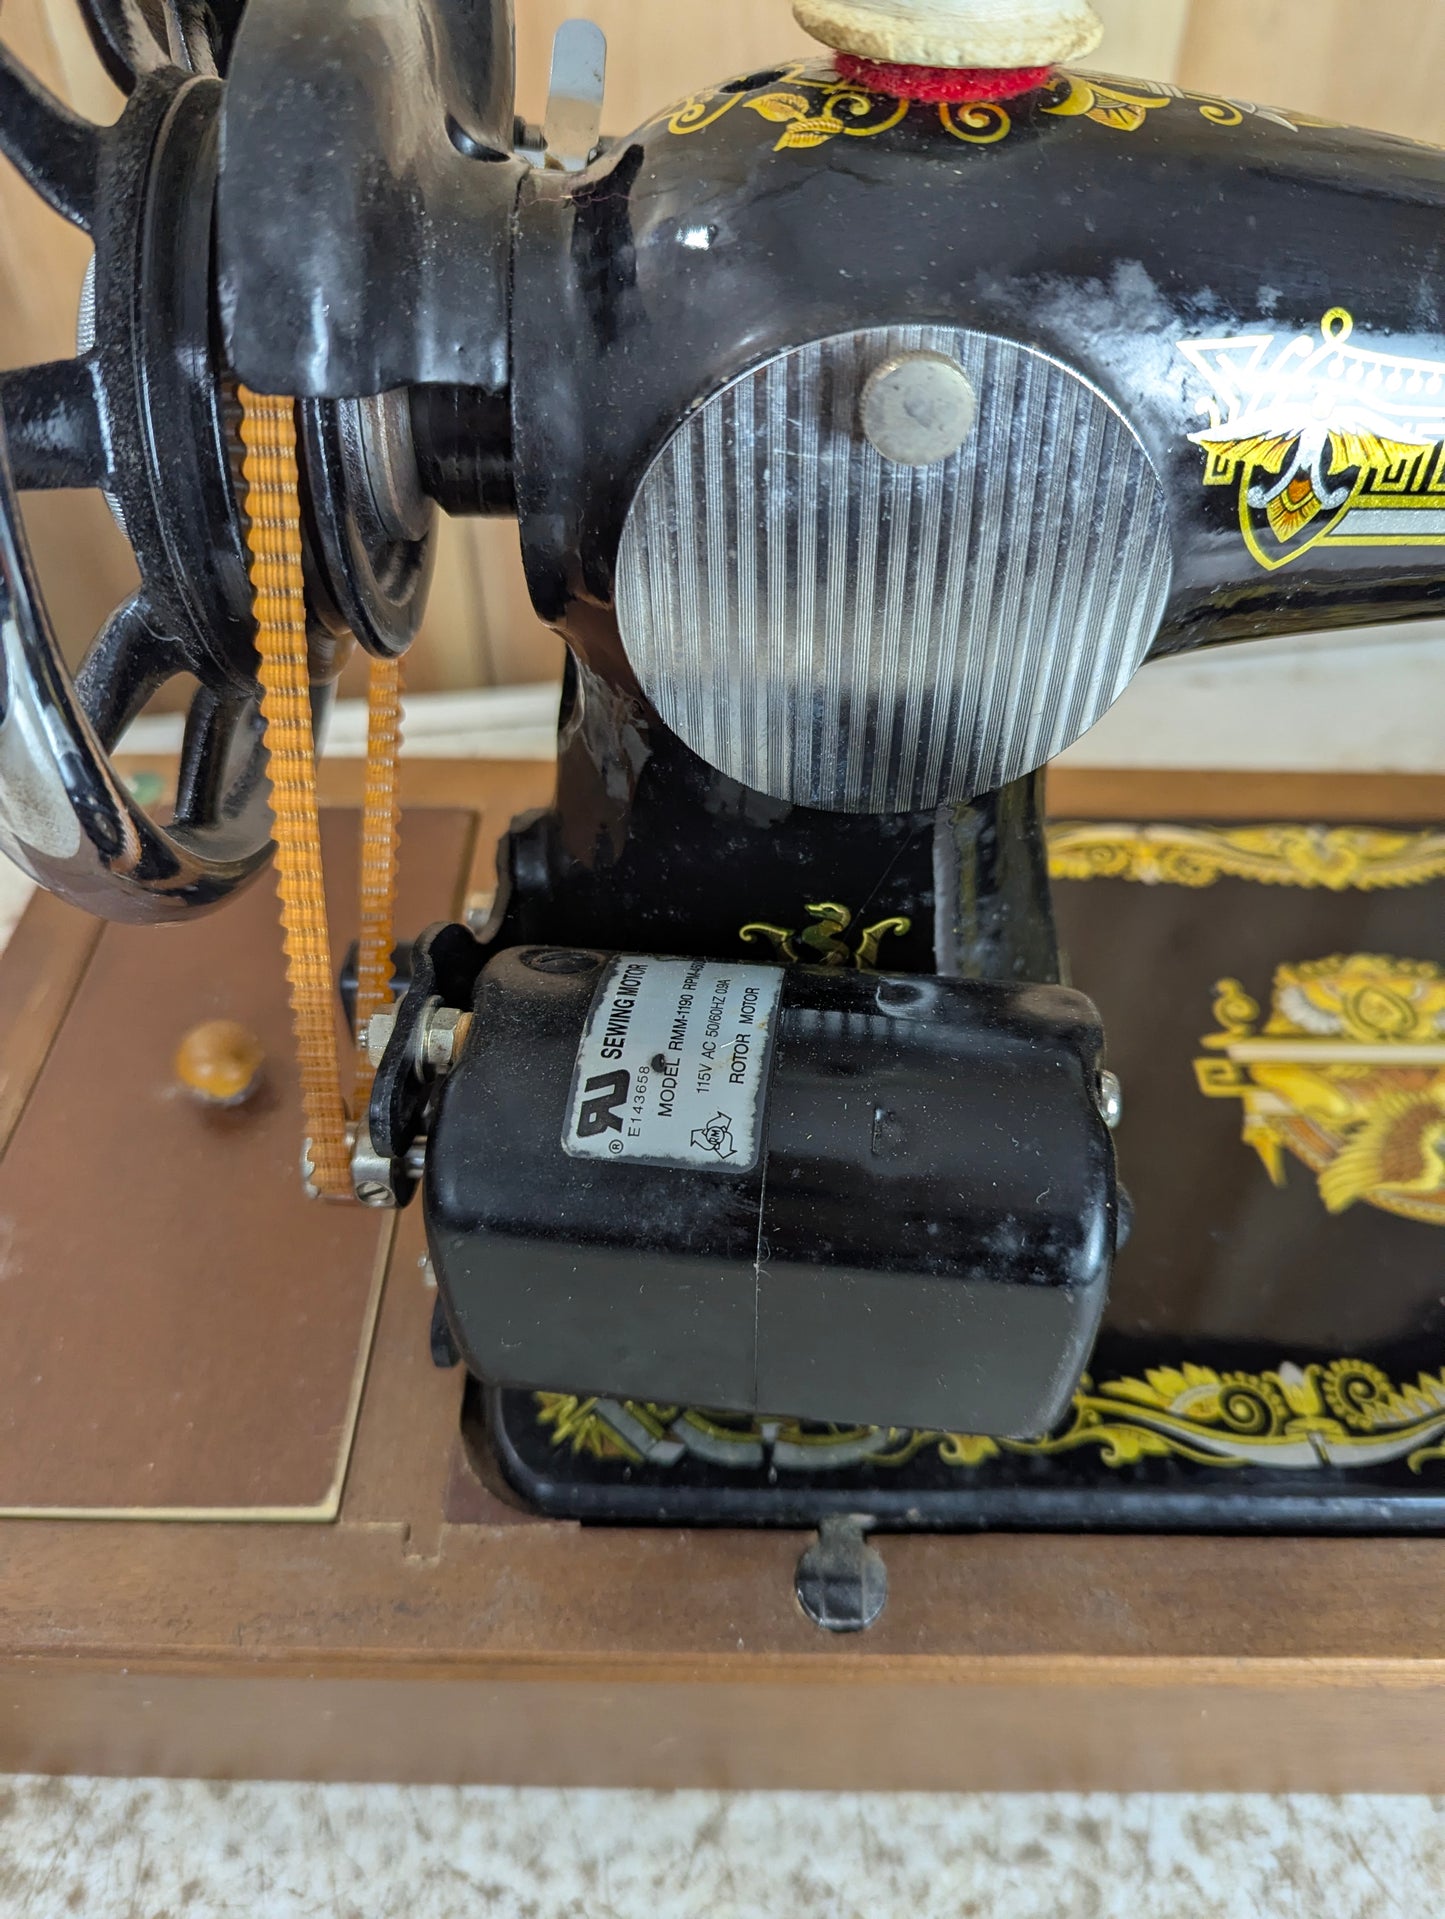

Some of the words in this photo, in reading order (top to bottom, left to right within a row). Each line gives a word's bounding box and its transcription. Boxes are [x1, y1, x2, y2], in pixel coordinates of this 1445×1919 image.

[616, 963, 649, 997] MOTOR
[668, 994, 694, 1051] RMM-1190
[705, 996, 726, 1038] 50/60HZ
[738, 986, 760, 1025] MOTOR
[600, 999, 635, 1060] SEWING
[701, 1041, 716, 1060] AC
[696, 1063, 712, 1094] 115V
[729, 1033, 751, 1085] ROTOR
[627, 1066, 650, 1137] E143658
[657, 1057, 680, 1117] MODEL
